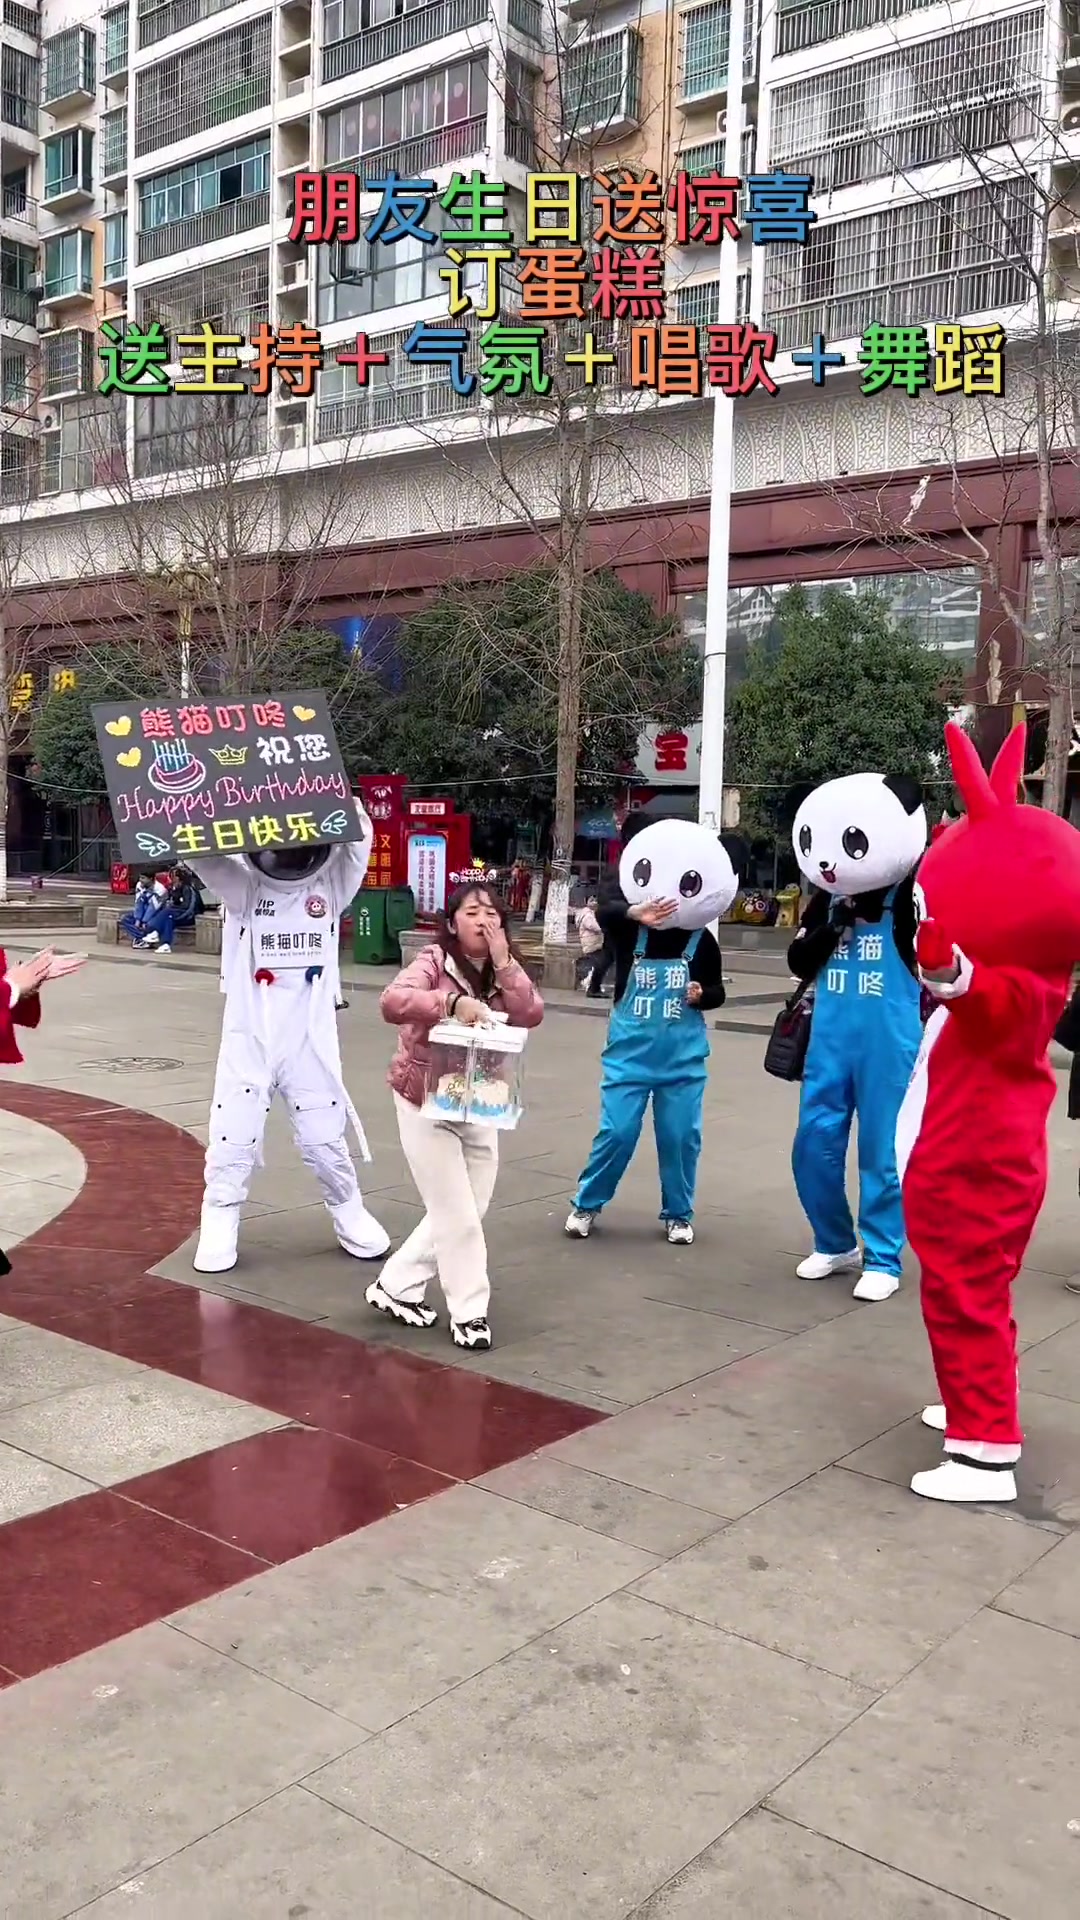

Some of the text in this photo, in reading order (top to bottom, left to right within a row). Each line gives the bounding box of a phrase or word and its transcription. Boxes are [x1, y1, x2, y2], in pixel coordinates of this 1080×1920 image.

[140, 700, 287, 738] 熊猫叮咚
[256, 734, 331, 766] 祝您
[117, 768, 346, 824] Happy Birthday
[172, 811, 322, 854] 生日快乐
[261, 932, 322, 950] 熊猫叮咚
[634, 965, 687, 990] 熊猫
[827, 968, 884, 997] 叮咚
[633, 996, 683, 1019] 叮咚
